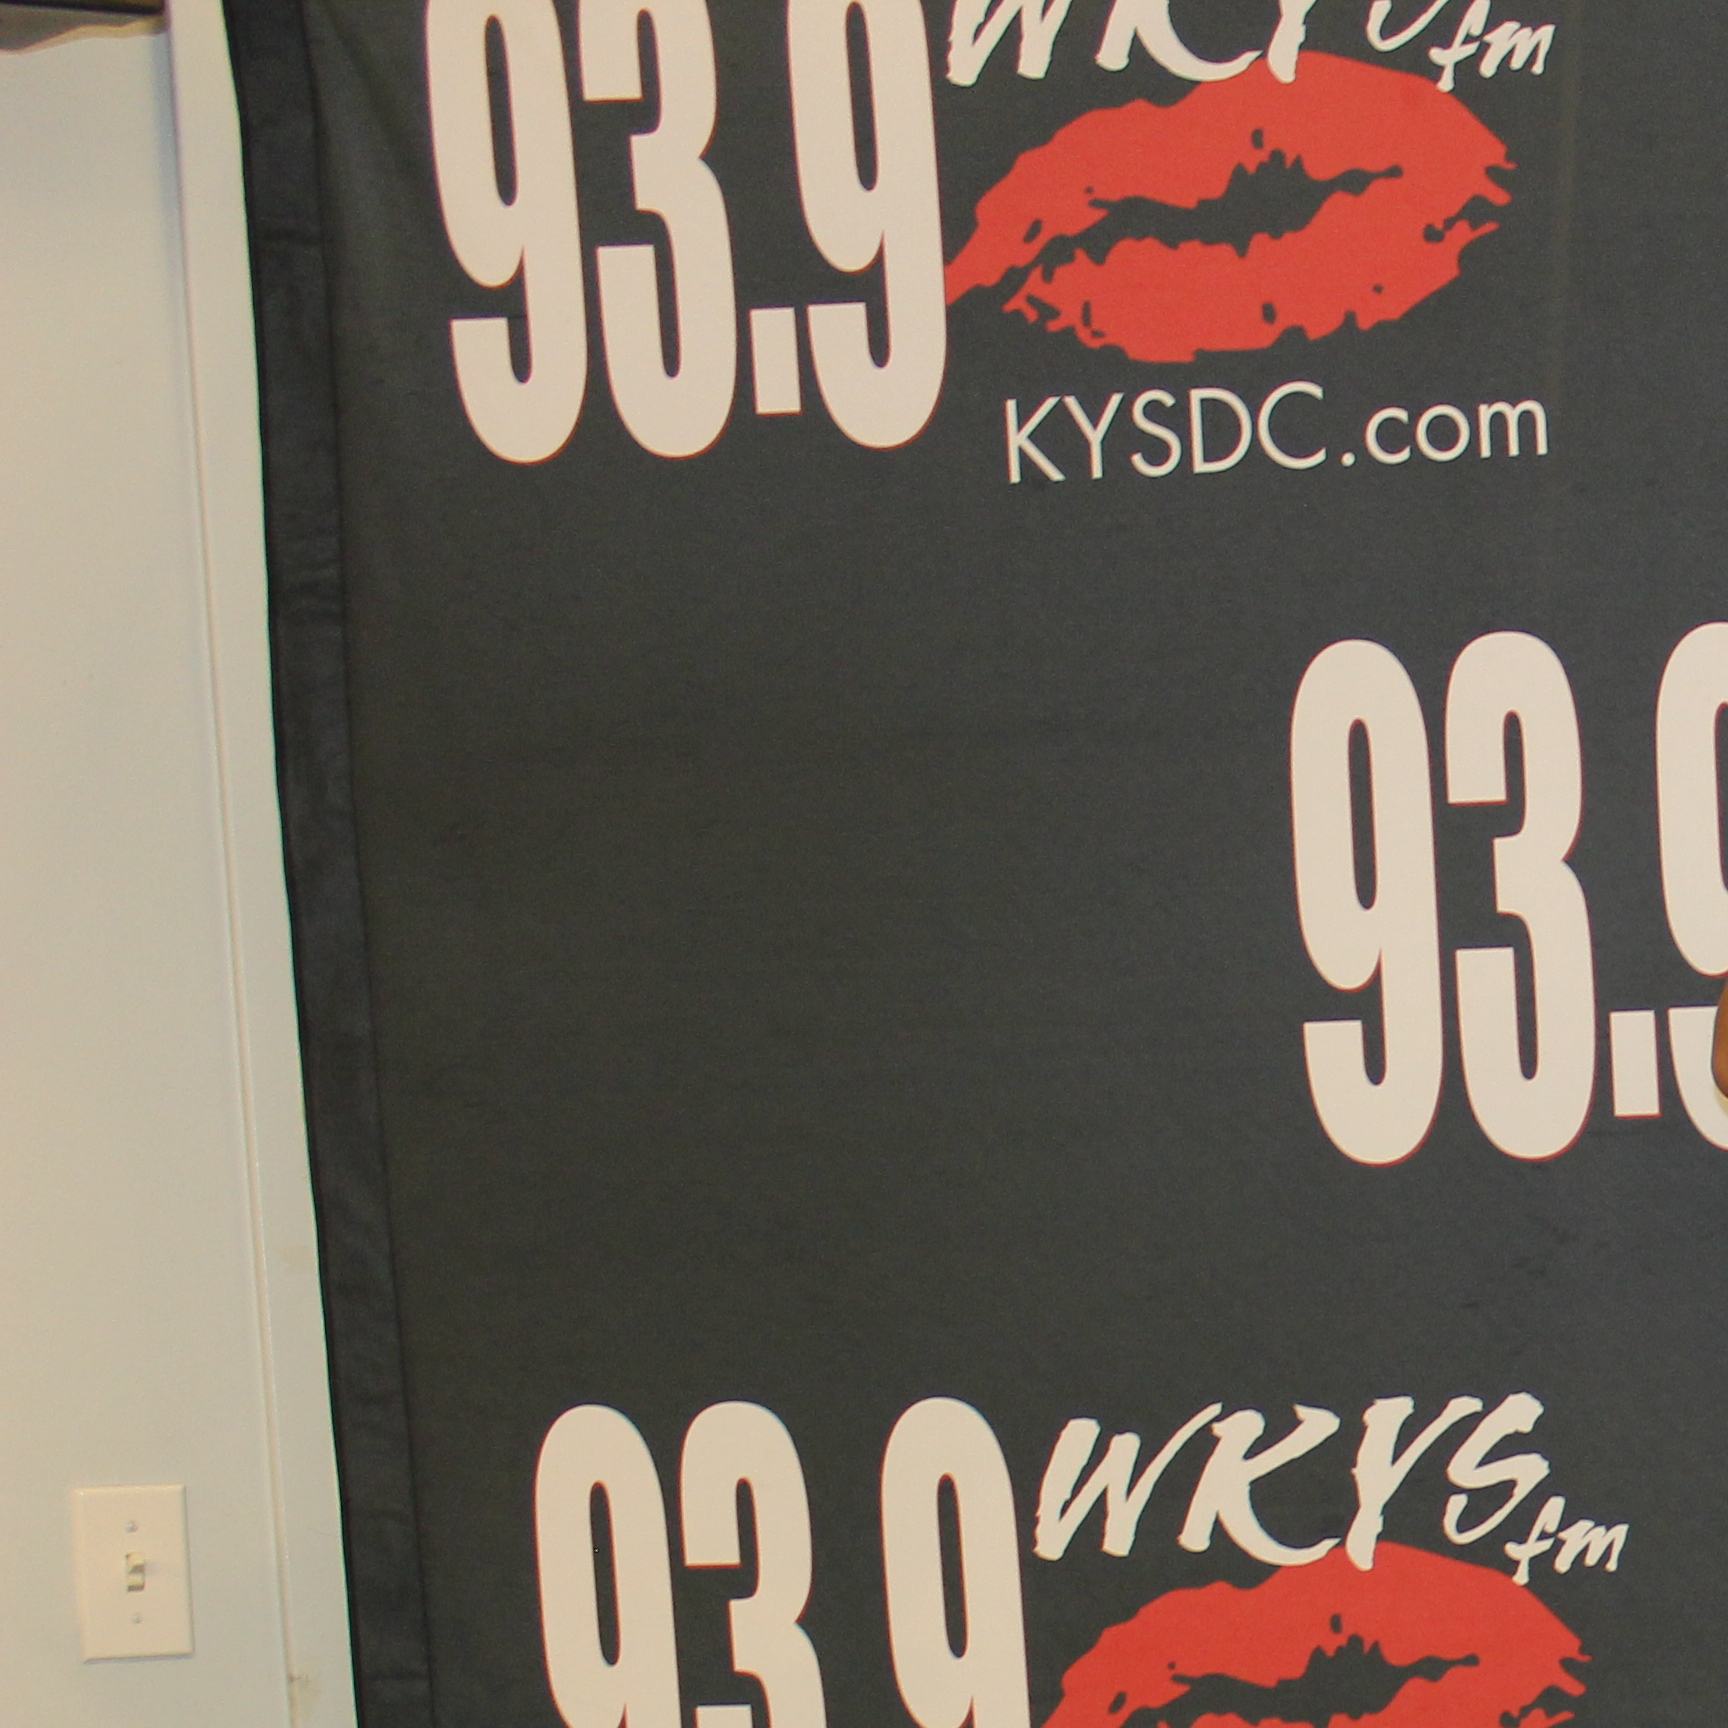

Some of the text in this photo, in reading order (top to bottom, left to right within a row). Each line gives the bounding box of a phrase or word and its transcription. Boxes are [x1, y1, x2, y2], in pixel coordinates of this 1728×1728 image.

[425, 0, 947, 462] 93.9
[1006, 381, 1548, 484] KYSDC.com
[1034, 1391, 1550, 1571] WKYS
[1505, 1495, 1630, 1585] fm
